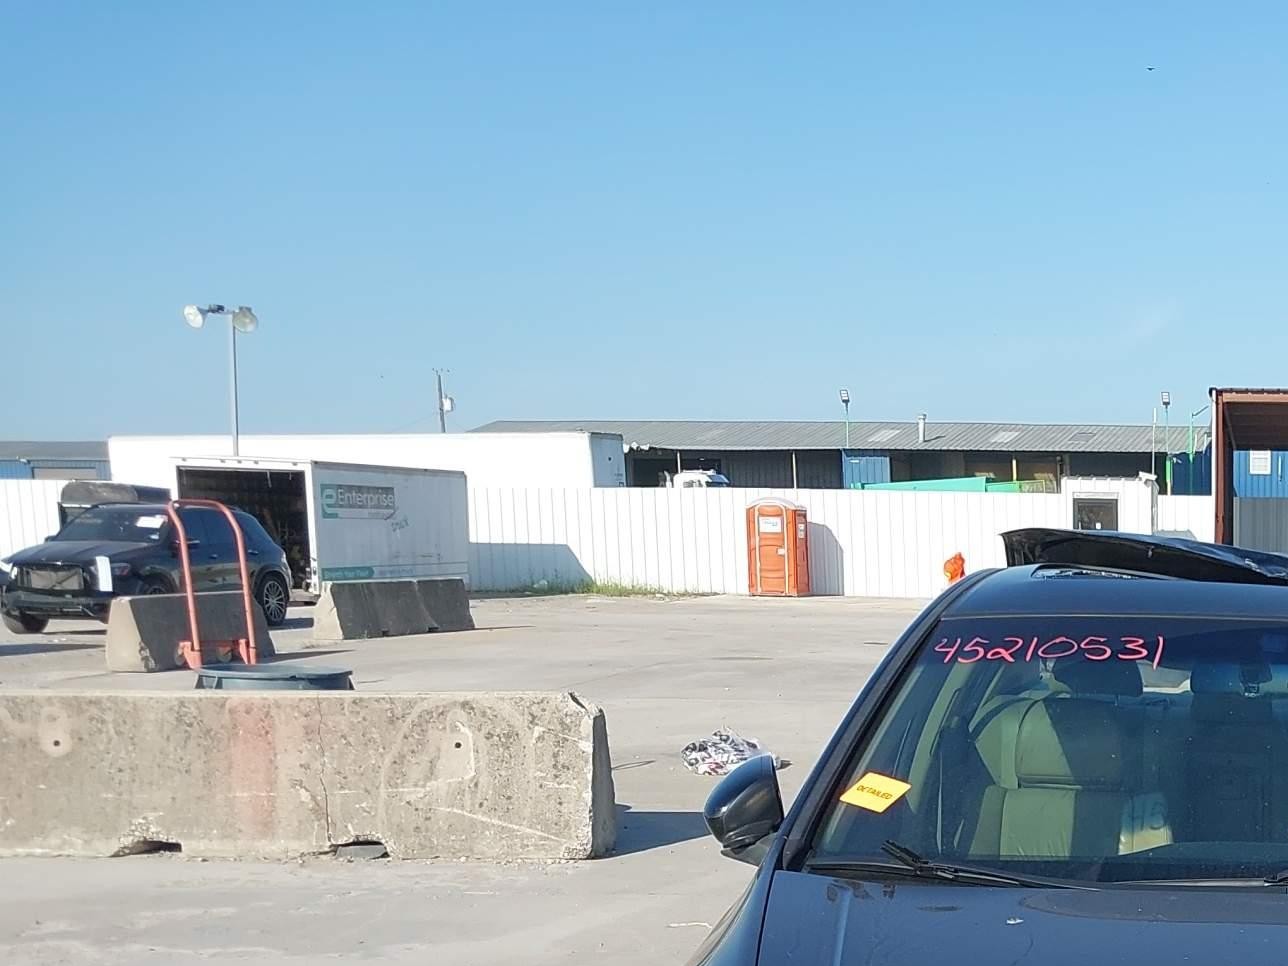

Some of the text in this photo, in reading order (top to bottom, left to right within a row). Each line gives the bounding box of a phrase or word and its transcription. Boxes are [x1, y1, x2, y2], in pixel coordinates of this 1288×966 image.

[338, 489, 394, 508] Enterprise
[934, 635, 1164, 670] 45210531
[857, 785, 893, 800] DETAILED
